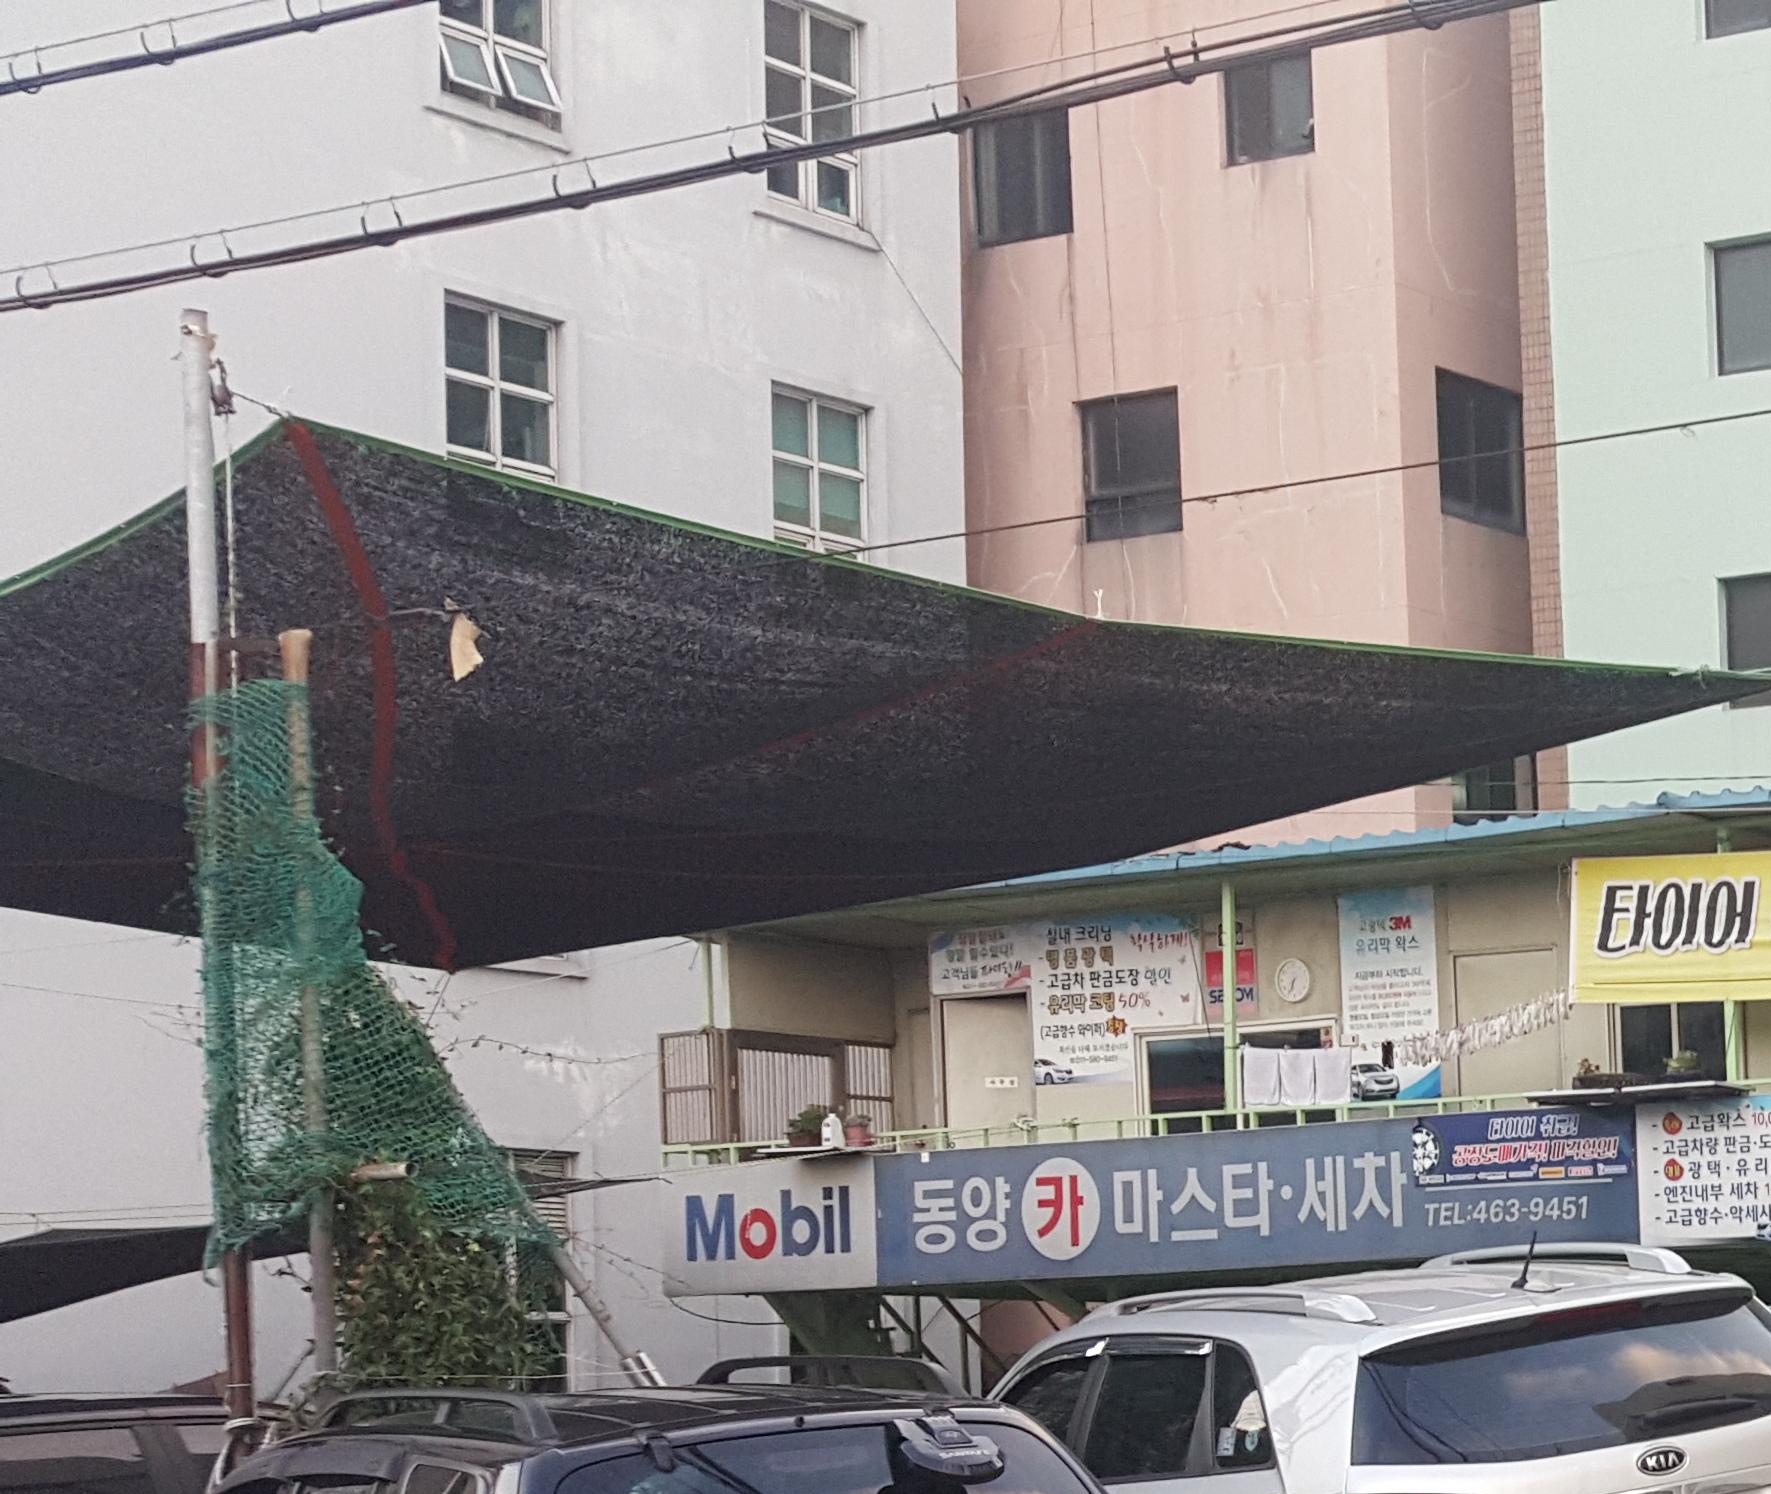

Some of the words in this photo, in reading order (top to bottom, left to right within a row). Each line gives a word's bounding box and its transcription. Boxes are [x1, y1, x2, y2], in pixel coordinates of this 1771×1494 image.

[1388, 915, 1412, 931] 3M
[1596, 879, 1757, 953] 타이어
[1047, 926, 1071, 946] 실내
[1074, 924, 1112, 942] 크리닝
[1355, 937, 1390, 955] 유리막
[1395, 935, 1420, 952] 왁스
[1047, 972, 1085, 991] 고급차
[1089, 968, 1140, 989] 판금도장
[1047, 993, 1087, 1015] 유리막
[1089, 991, 1116, 1013] 코팅
[1118, 991, 1151, 1009] 50%
[1209, 987, 1255, 1005] SEOM
[1488, 1114, 1537, 1140] 타이어
[1686, 1111, 1747, 1132] 고급왁스
[1662, 1136, 1720, 1157] 고급차량
[1663, 1182, 1725, 1204] 엔진내부
[1729, 1181, 1759, 1200] 세차
[911, 1176, 1013, 1255] 동양
[1034, 1174, 1086, 1251] 카
[1424, 1194, 1589, 1228] TEL:463-9451
[685, 1184, 852, 1263] Mobil
